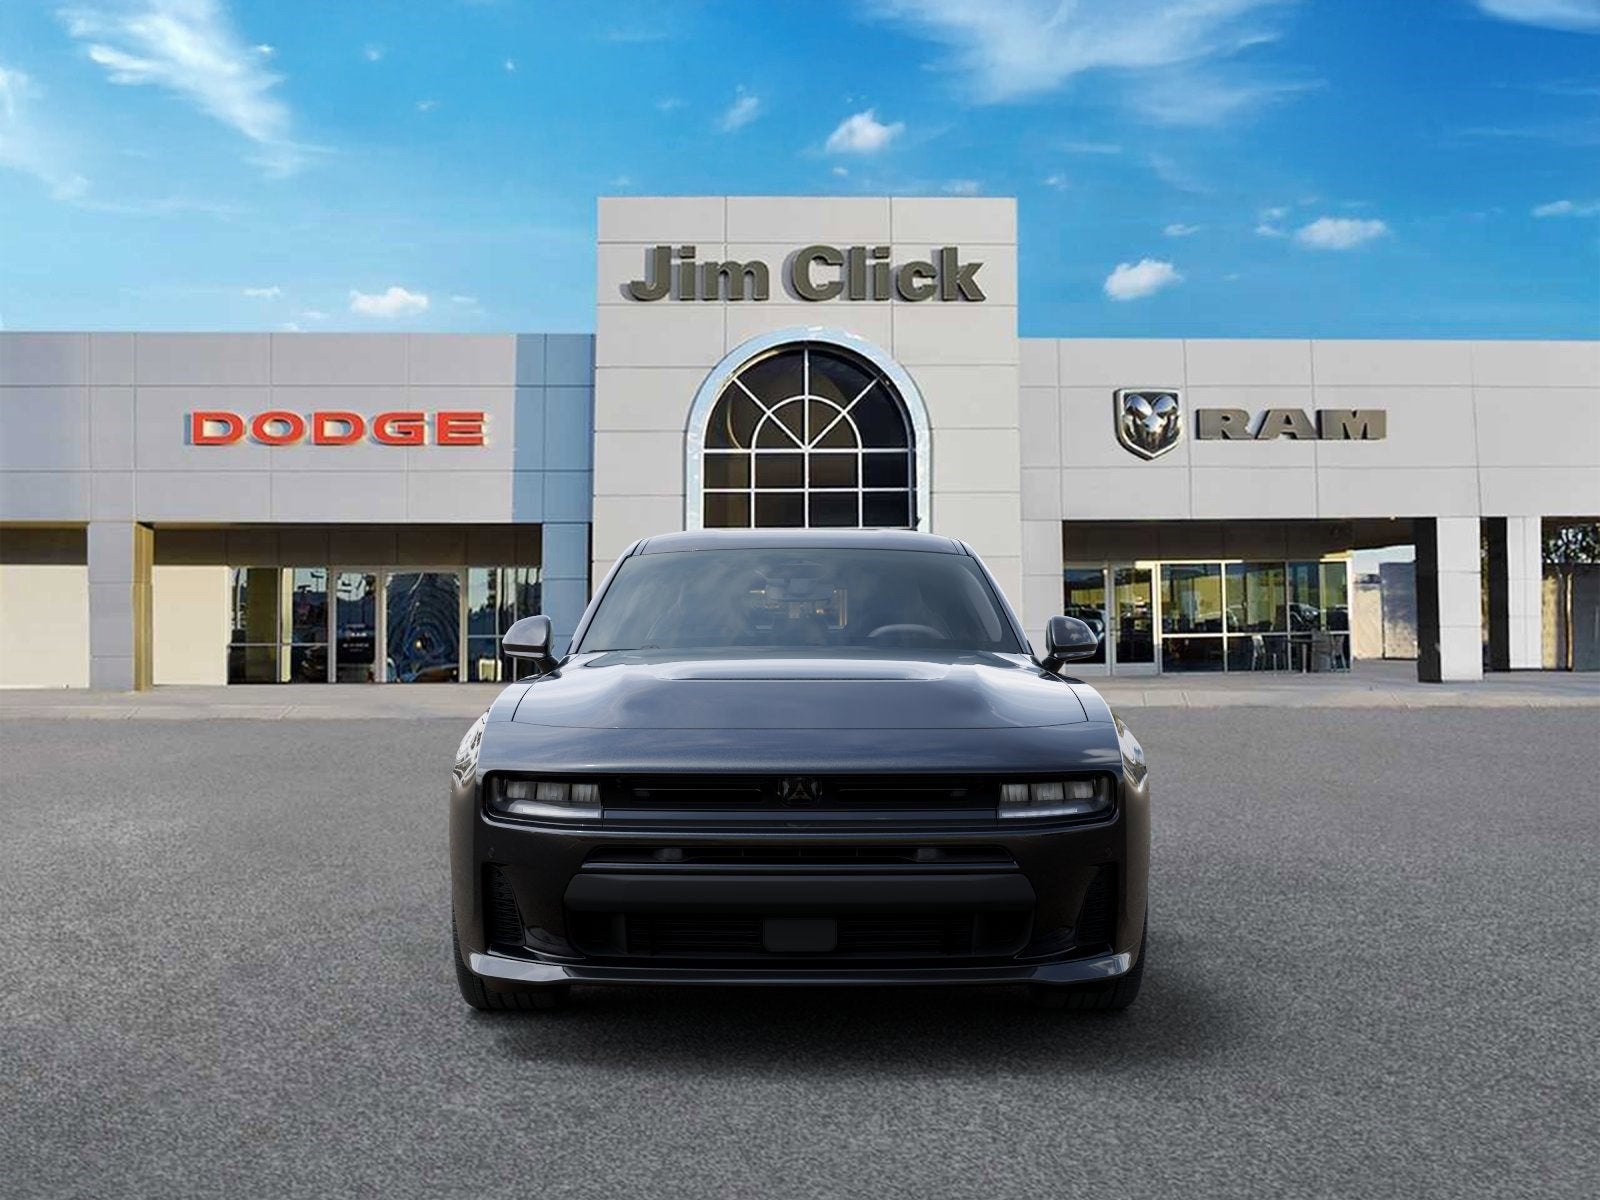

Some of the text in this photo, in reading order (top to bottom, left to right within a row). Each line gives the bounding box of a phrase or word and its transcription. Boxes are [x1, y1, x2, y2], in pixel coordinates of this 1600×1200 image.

[627, 245, 986, 302] Jim Click
[190, 410, 486, 446] DODGE
[1196, 408, 1387, 440] RAM
